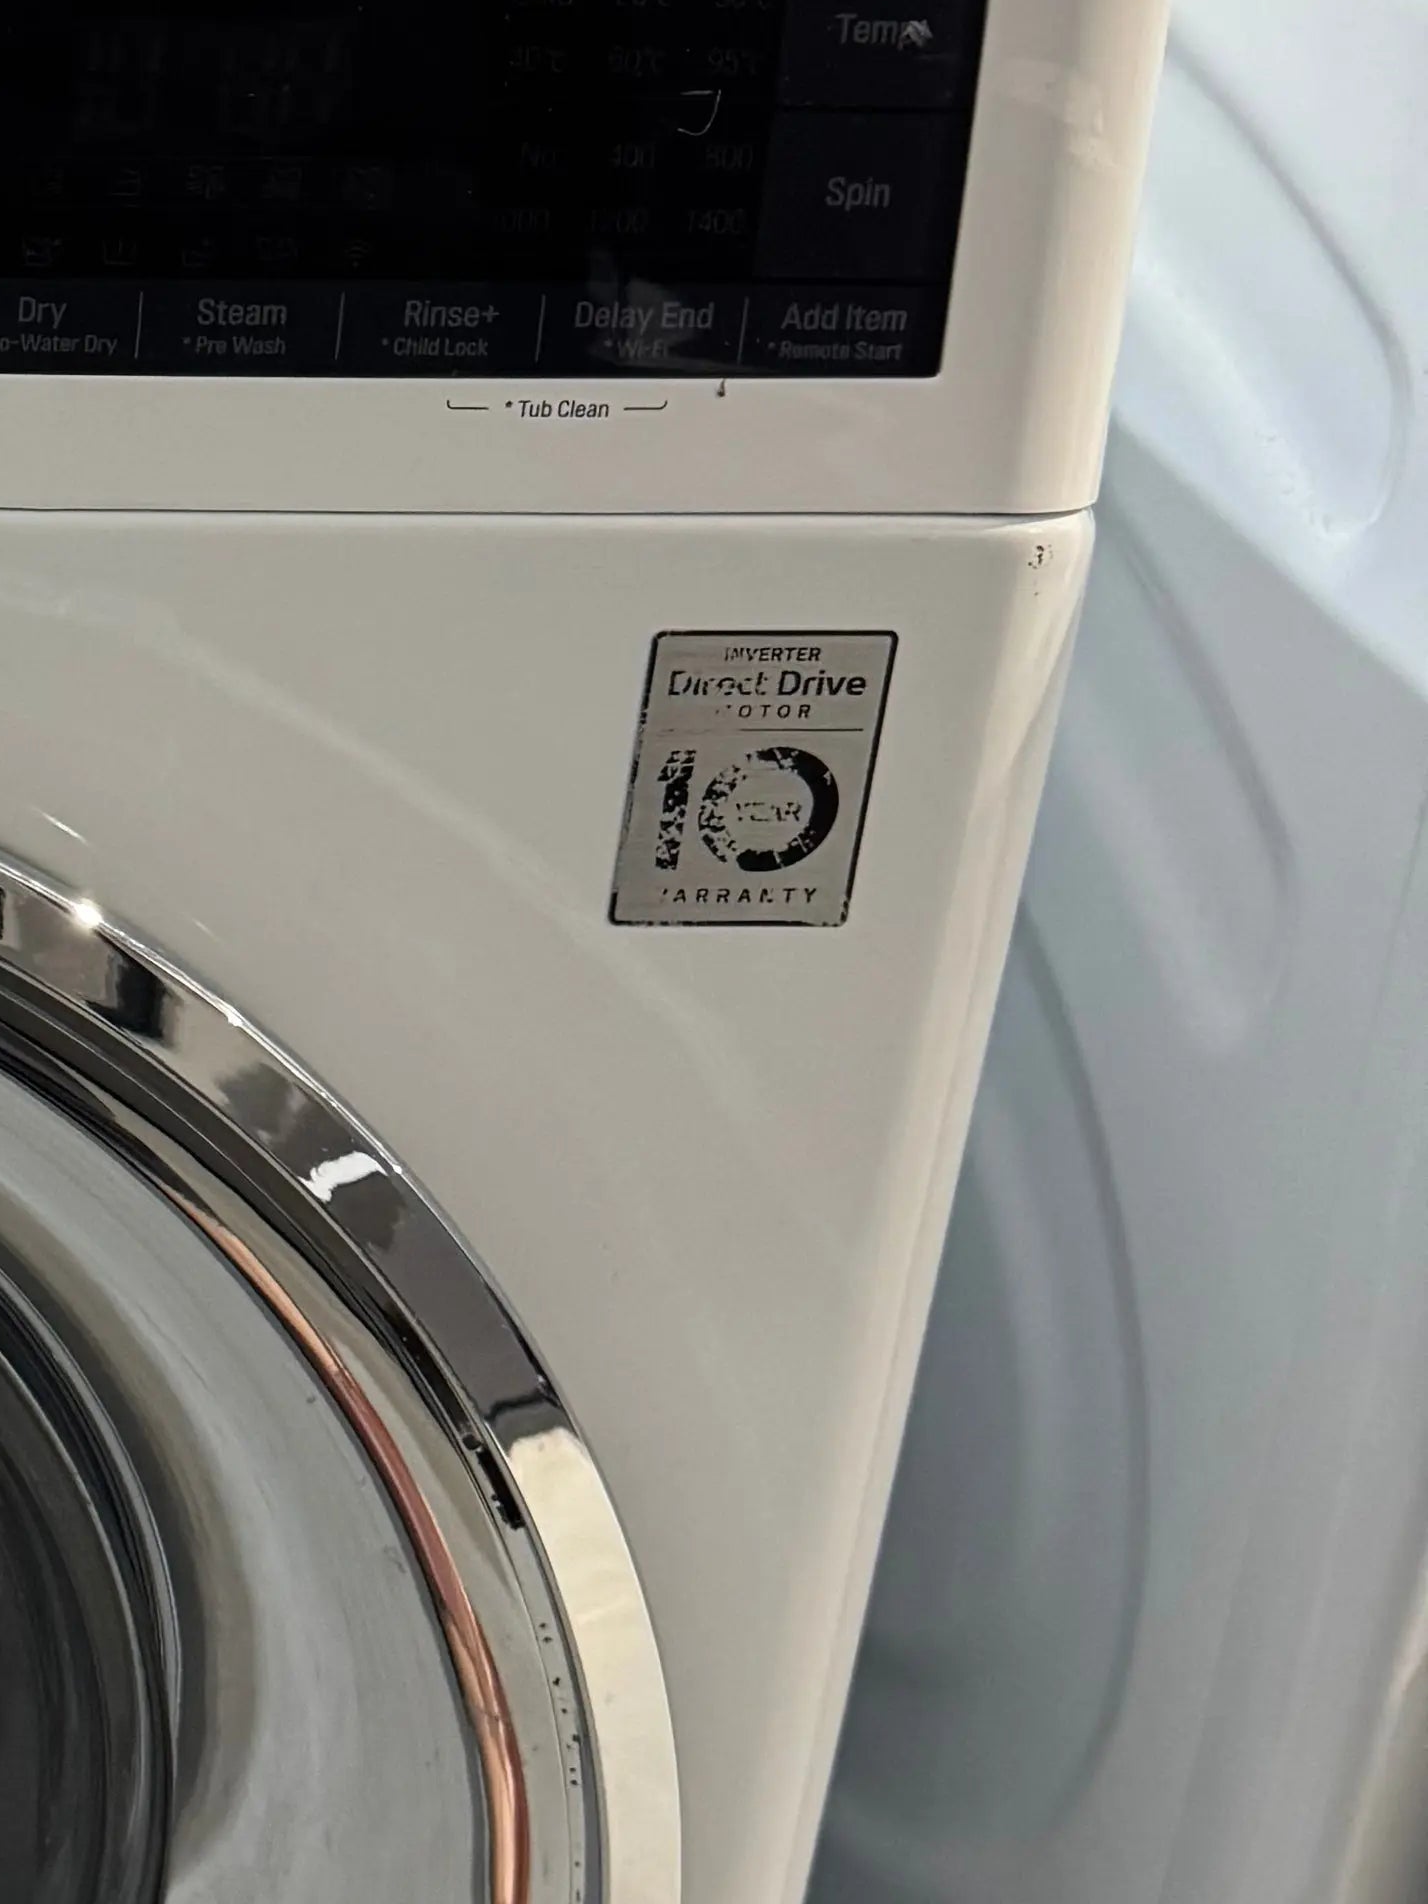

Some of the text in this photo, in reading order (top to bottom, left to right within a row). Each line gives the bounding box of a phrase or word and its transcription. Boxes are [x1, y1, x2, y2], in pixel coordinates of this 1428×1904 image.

[826, 177, 890, 211] Spin
[18, 297, 67, 329] Dry
[197, 298, 287, 326] Steam
[405, 300, 500, 328] Rinse+
[574, 301, 714, 336] Delay End
[781, 303, 908, 332] Add Item
[84, 334, 118, 358] Dry
[196, 336, 286, 356] Pre Wash
[393, 337, 488, 357] Child Lock
[778, 341, 902, 361] Remote Start
[519, 400, 609, 418] Tub Clean
[668, 670, 866, 696] Direct Drive
[716, 704, 811, 719] OTOR
[659, 888, 817, 903] ARRANTY
